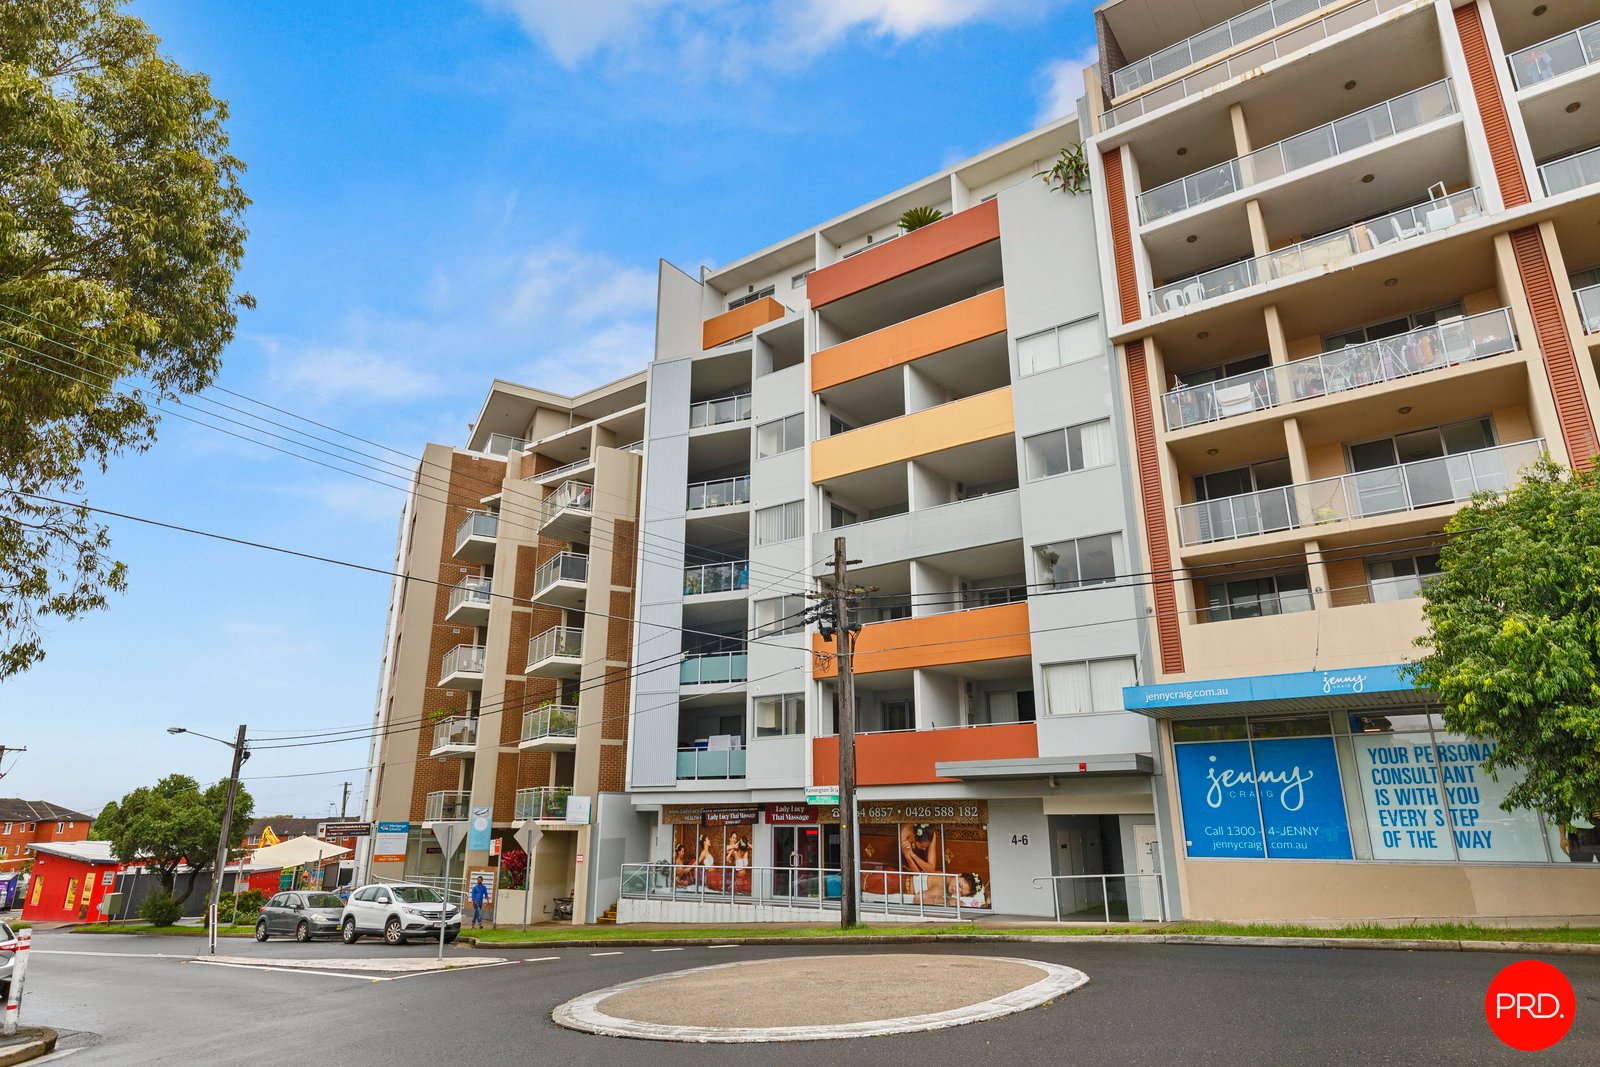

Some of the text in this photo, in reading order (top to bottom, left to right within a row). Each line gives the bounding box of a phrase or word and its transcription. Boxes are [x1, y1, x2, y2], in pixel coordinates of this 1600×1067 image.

[1323, 672, 1367, 694] jenny
[1145, 687, 1229, 703] jennycraig.com.au
[1368, 747, 1409, 765] YOUR
[1206, 755, 1314, 812] jenny
[1371, 765, 1475, 785] CONSULTANT
[1375, 786, 1480, 806] IS WITH YOU
[772, 813, 809, 821] Thai Massage
[776, 805, 790, 813] Lady
[868, 807, 893, 818] 6857
[905, 806, 931, 818] 0426
[934, 806, 954, 818] 588
[959, 805, 978, 817] 182
[1378, 808, 1479, 827] EVERY STEP
[1011, 834, 1029, 846] 4-6
[1204, 826, 1224, 837] Call
[1227, 826, 1256, 837] 1300
[1267, 826, 1319, 837] 4-JENNY
[1382, 830, 1492, 849] OF THE WAY
